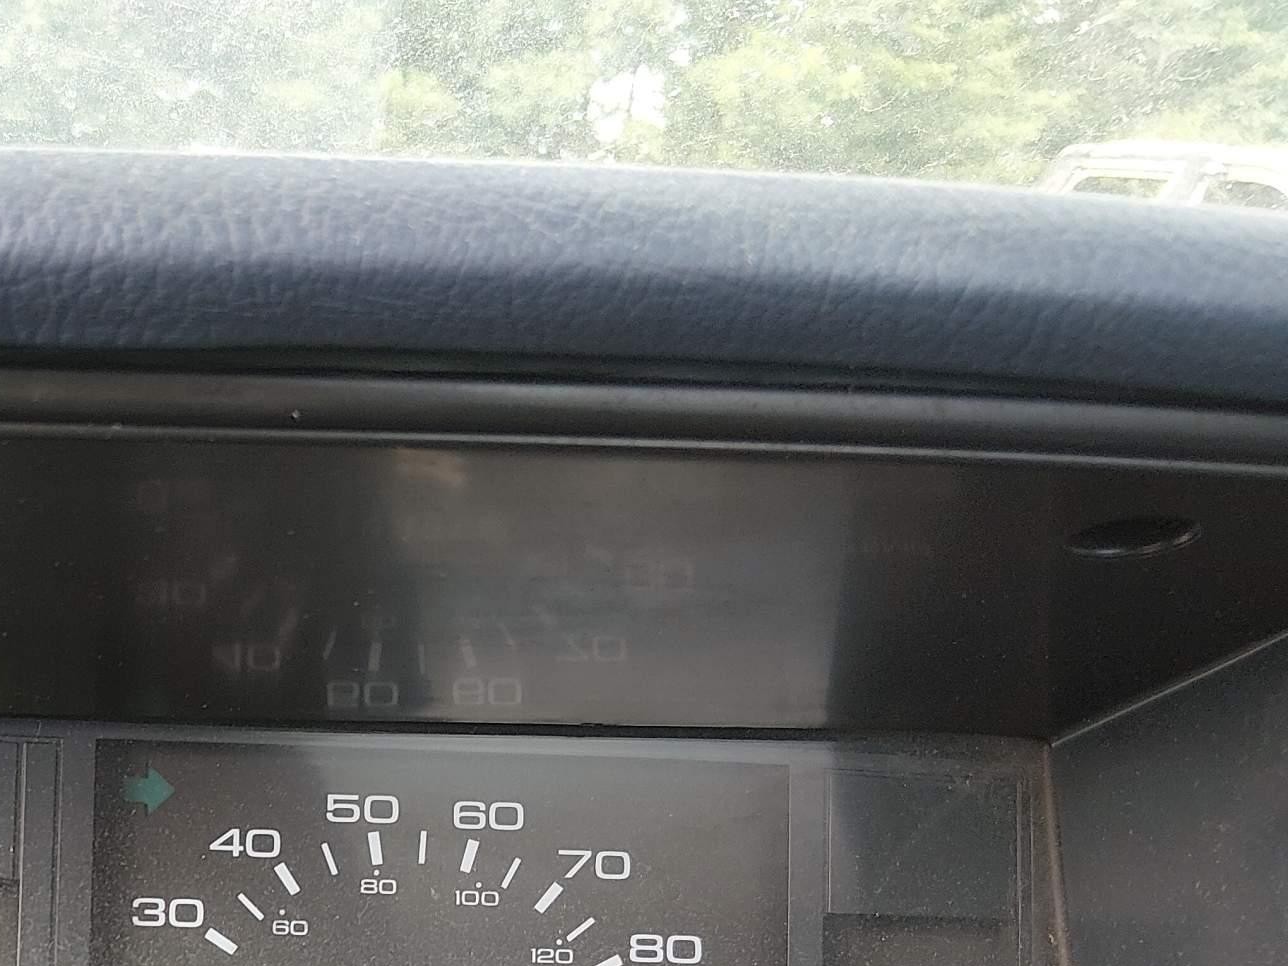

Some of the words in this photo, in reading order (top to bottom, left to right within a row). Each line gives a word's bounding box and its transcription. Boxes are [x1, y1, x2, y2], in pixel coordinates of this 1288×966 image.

[325, 793, 399, 824] 50
[453, 800, 524, 831] 60
[209, 828, 281, 858] 40
[558, 849, 631, 880] 70
[360, 879, 397, 895] 80
[455, 889, 500, 907] 100
[131, 897, 205, 928] 30
[272, 919, 309, 936] 60
[530, 948, 574, 964] 120
[629, 933, 702, 964] 80
